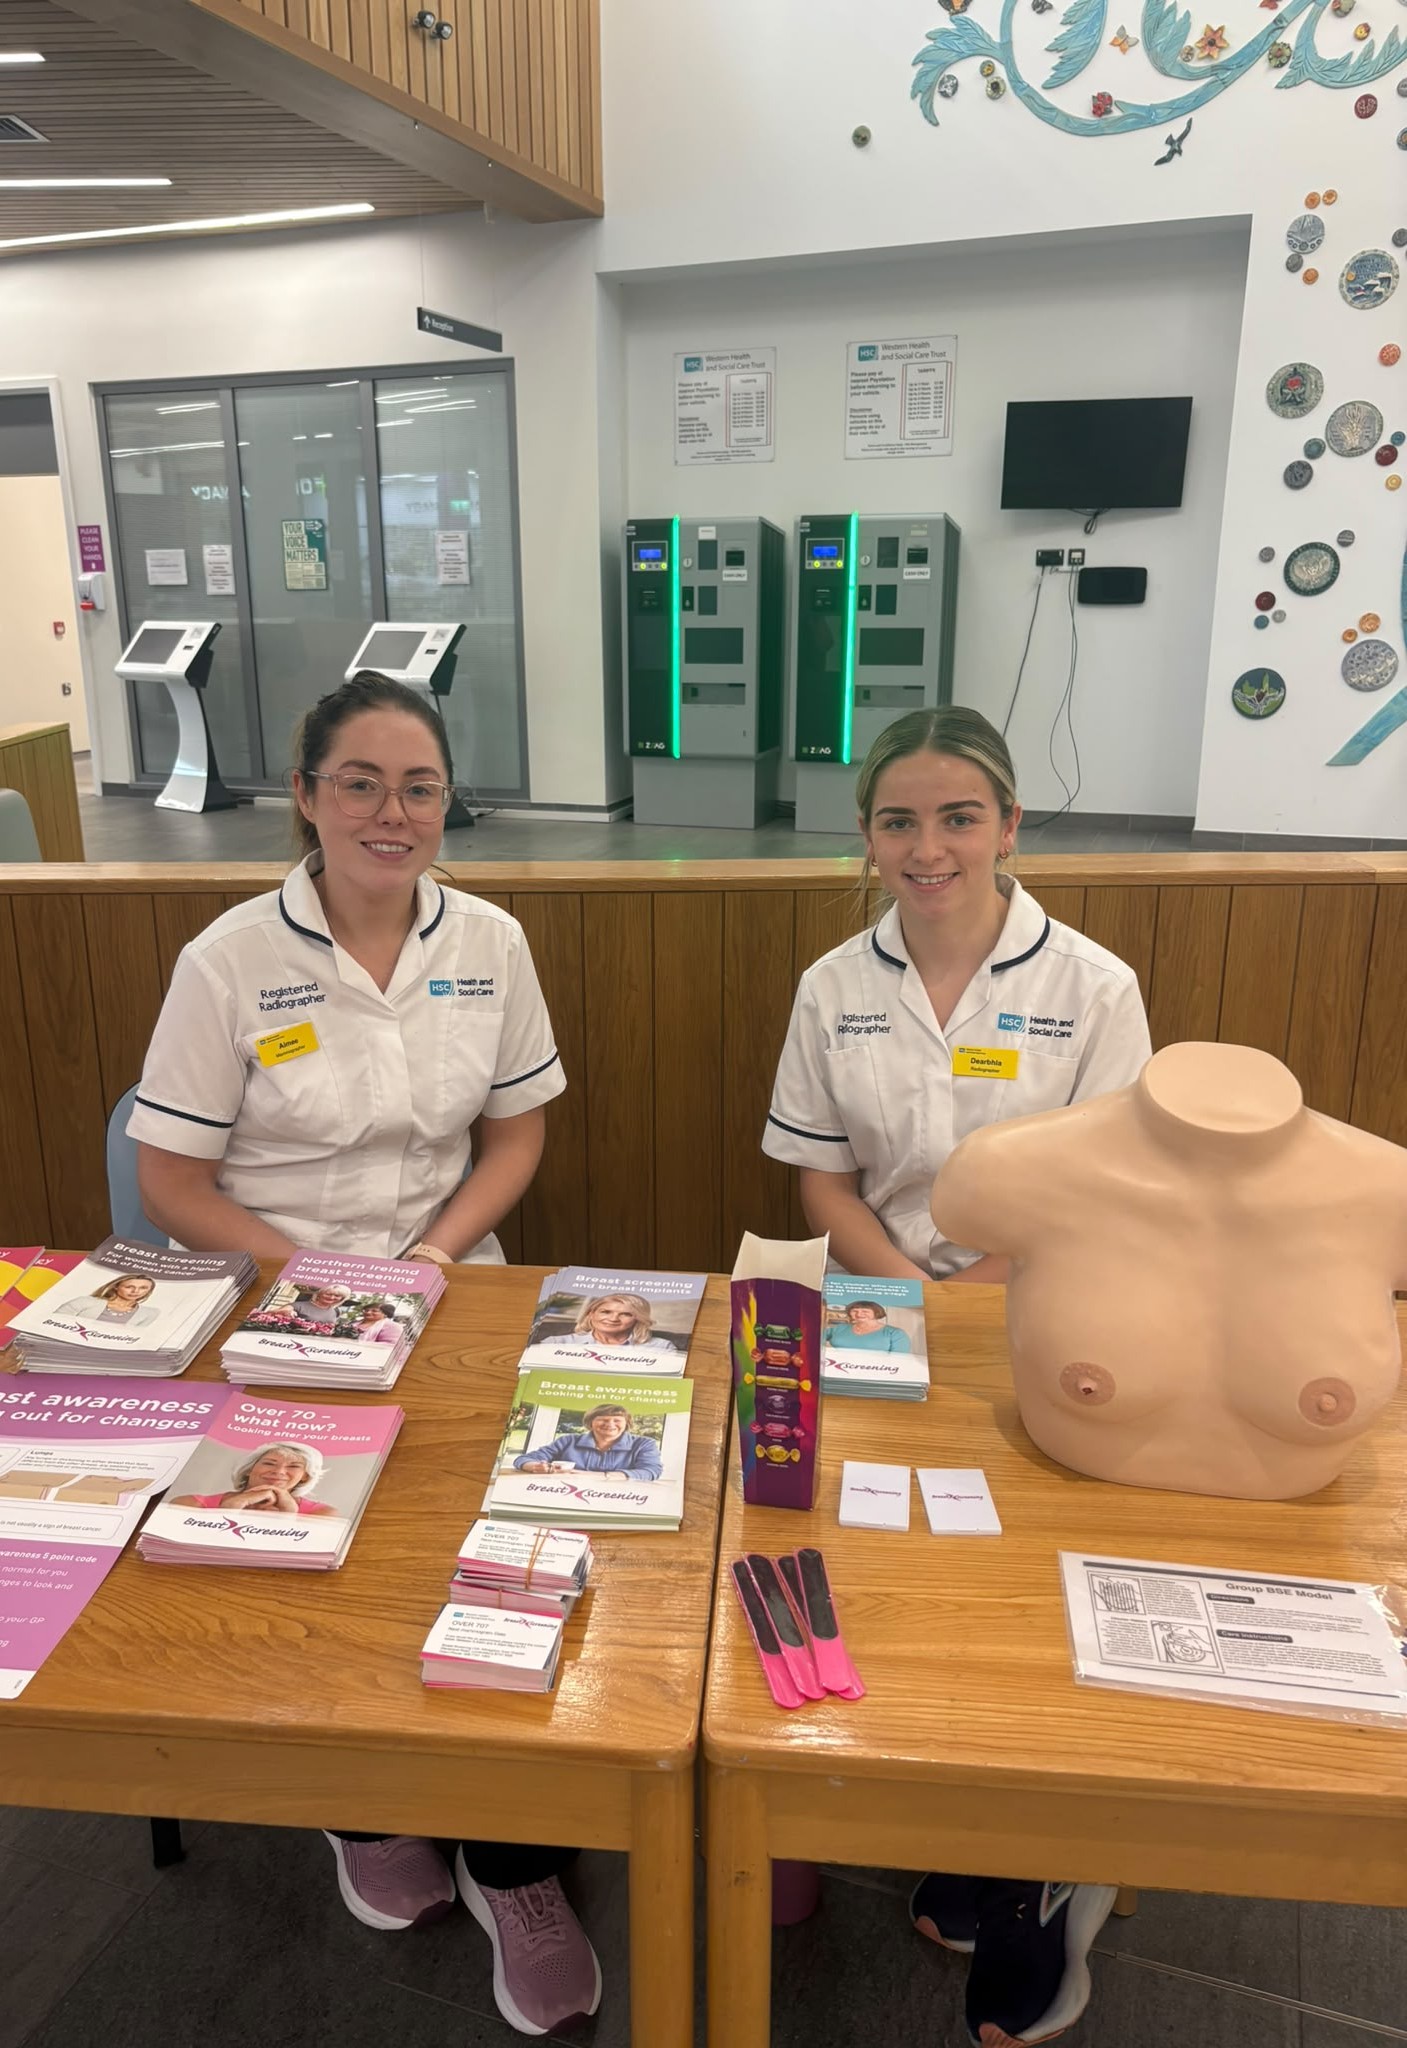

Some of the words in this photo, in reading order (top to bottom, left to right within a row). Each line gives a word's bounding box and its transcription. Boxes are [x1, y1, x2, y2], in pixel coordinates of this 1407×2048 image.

[881, 343, 908, 351] Western
[909, 342, 930, 350] Health
[895, 352, 914, 360] Social
[284, 522, 302, 534] YOUR
[285, 536, 305, 547] VOICE
[286, 550, 316, 561] MATTERS
[260, 982, 318, 999] Registered
[258, 994, 326, 1012] Radiographer
[1002, 1018, 1020, 1027] HSC
[1030, 1016, 1056, 1027] Health
[1058, 1018, 1074, 1028] and
[1028, 1028, 1052, 1038] Social
[1054, 1029, 1072, 1038] Care
[106, 1250, 122, 1259] For
[125, 1255, 158, 1266] women
[191, 1264, 221, 1273] higher
[113, 1243, 158, 1259] Breast
[160, 1249, 227, 1267] screening
[101, 1256, 118, 1266] risk
[120, 1259, 131, 1268] of
[132, 1261, 162, 1274] breast
[302, 1256, 366, 1270] Northern
[369, 1264, 420, 1276] Ireland
[290, 1273, 330, 1283] Helping
[353, 1280, 387, 1288] decide
[296, 1265, 341, 1276] breast
[345, 1271, 416, 1285] screening
[576, 1274, 620, 1285] Breast
[624, 1278, 693, 1289] screening
[598, 1284, 636, 1292] breast
[639, 1286, 691, 1295] implants
[42, 1319, 76, 1332] Breast
[88, 1331, 141, 1344] Screening
[258, 1338, 292, 1349] Breast
[307, 1346, 362, 1359] Screening
[554, 1350, 588, 1358] Breast
[603, 1354, 657, 1365] Screening
[844, 1363, 900, 1374] Screening
[538, 1389, 584, 1399] Looking
[629, 1395, 677, 1404] changes
[540, 1380, 591, 1392] Breast
[595, 1386, 678, 1397] awareness
[42, 1394, 214, 1414] awareness
[240, 1403, 286, 1417] Over
[292, 1409, 316, 1420] 70
[10, 1410, 53, 1422] out
[58, 1412, 94, 1424] for
[100, 1415, 202, 1430] changes
[234, 1413, 280, 1428] what
[285, 1421, 336, 1432] now?
[227, 1423, 272, 1436] Looking
[274, 1430, 301, 1439] after
[303, 1434, 328, 1442] your
[526, 1483, 567, 1494] Breast
[584, 1489, 648, 1504] Screening
[184, 1517, 227, 1529] Breast
[242, 1525, 309, 1541] Screening
[1226, 1583, 1263, 1594] Group
[1266, 1586, 1293, 1596] BSE
[1295, 1590, 1333, 1600] Model
